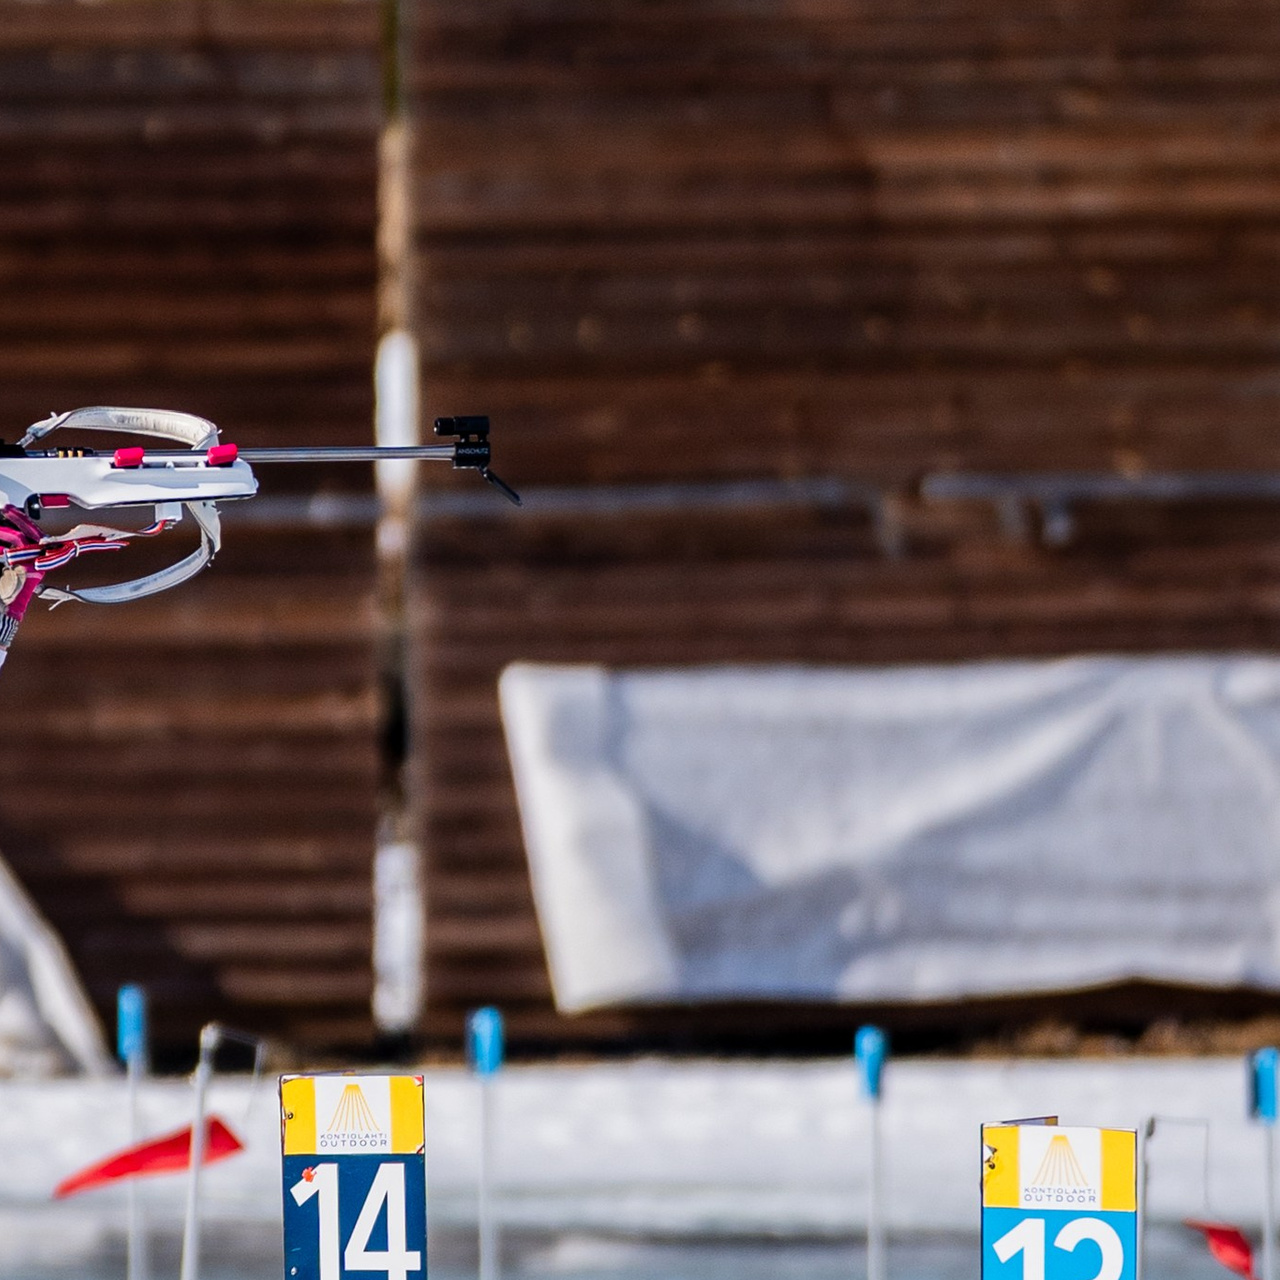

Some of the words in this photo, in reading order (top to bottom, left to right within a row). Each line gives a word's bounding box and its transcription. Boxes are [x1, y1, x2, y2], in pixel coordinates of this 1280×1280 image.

[320, 1132, 388, 1140] KONTIOLAHTI
[320, 1139, 388, 1148] OUTDOOR
[1024, 1186, 1097, 1195] KONTIOLAHTI
[1023, 1193, 1097, 1203] OUTDOOR
